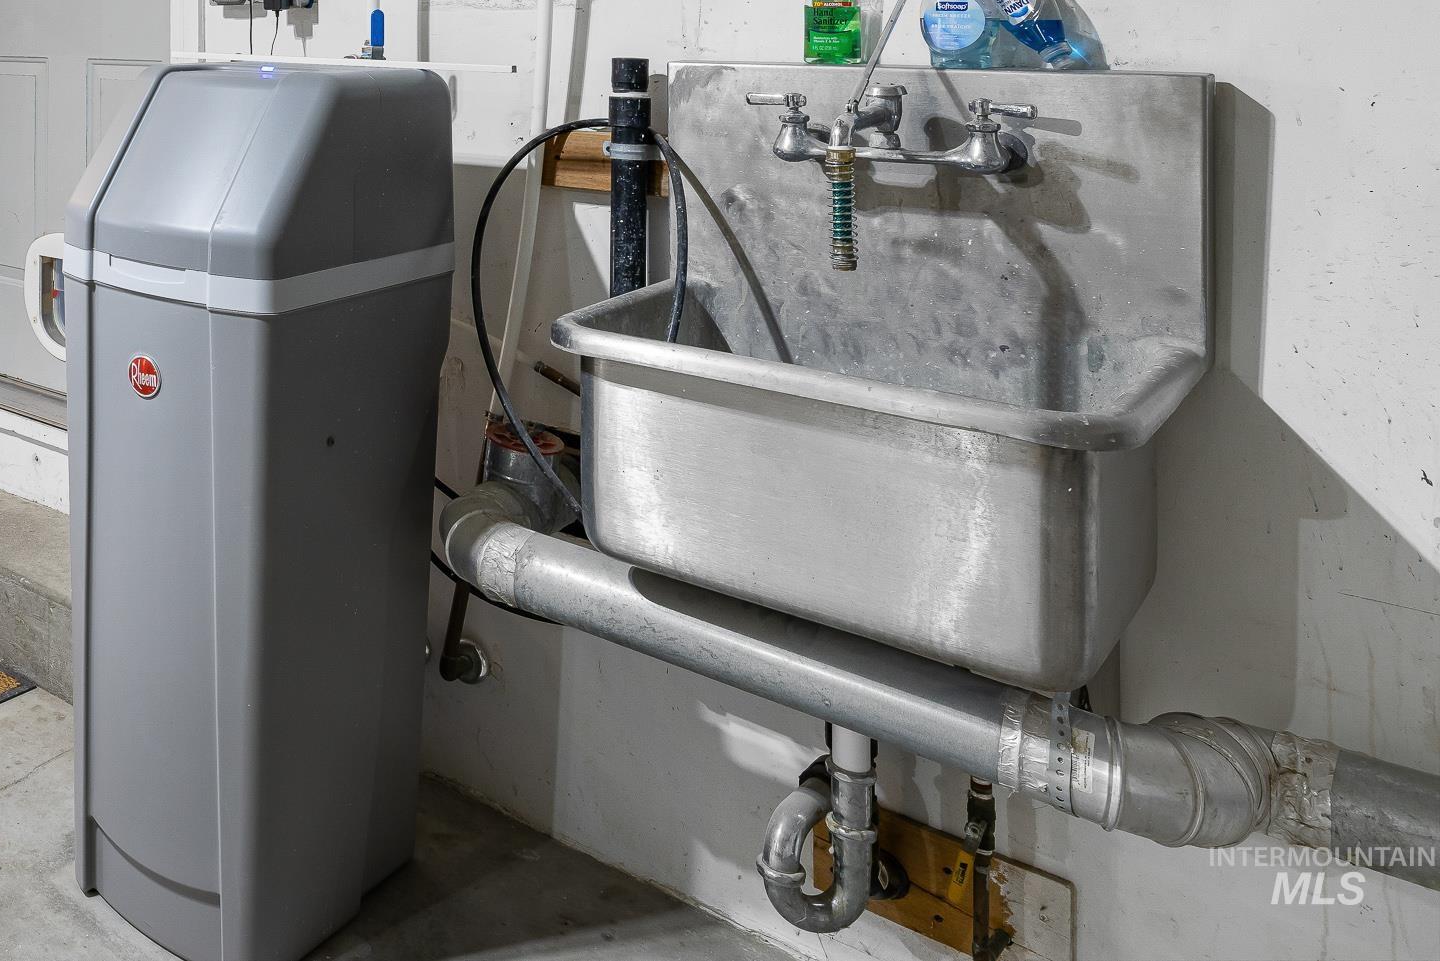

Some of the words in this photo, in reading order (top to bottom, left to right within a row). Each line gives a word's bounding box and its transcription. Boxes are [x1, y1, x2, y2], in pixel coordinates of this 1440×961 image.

[937, 2, 968, 10] Softsoap
[813, 8, 834, 16] Hand
[813, 16, 849, 25] Sanitizer
[131, 359, 157, 390] Rheem
